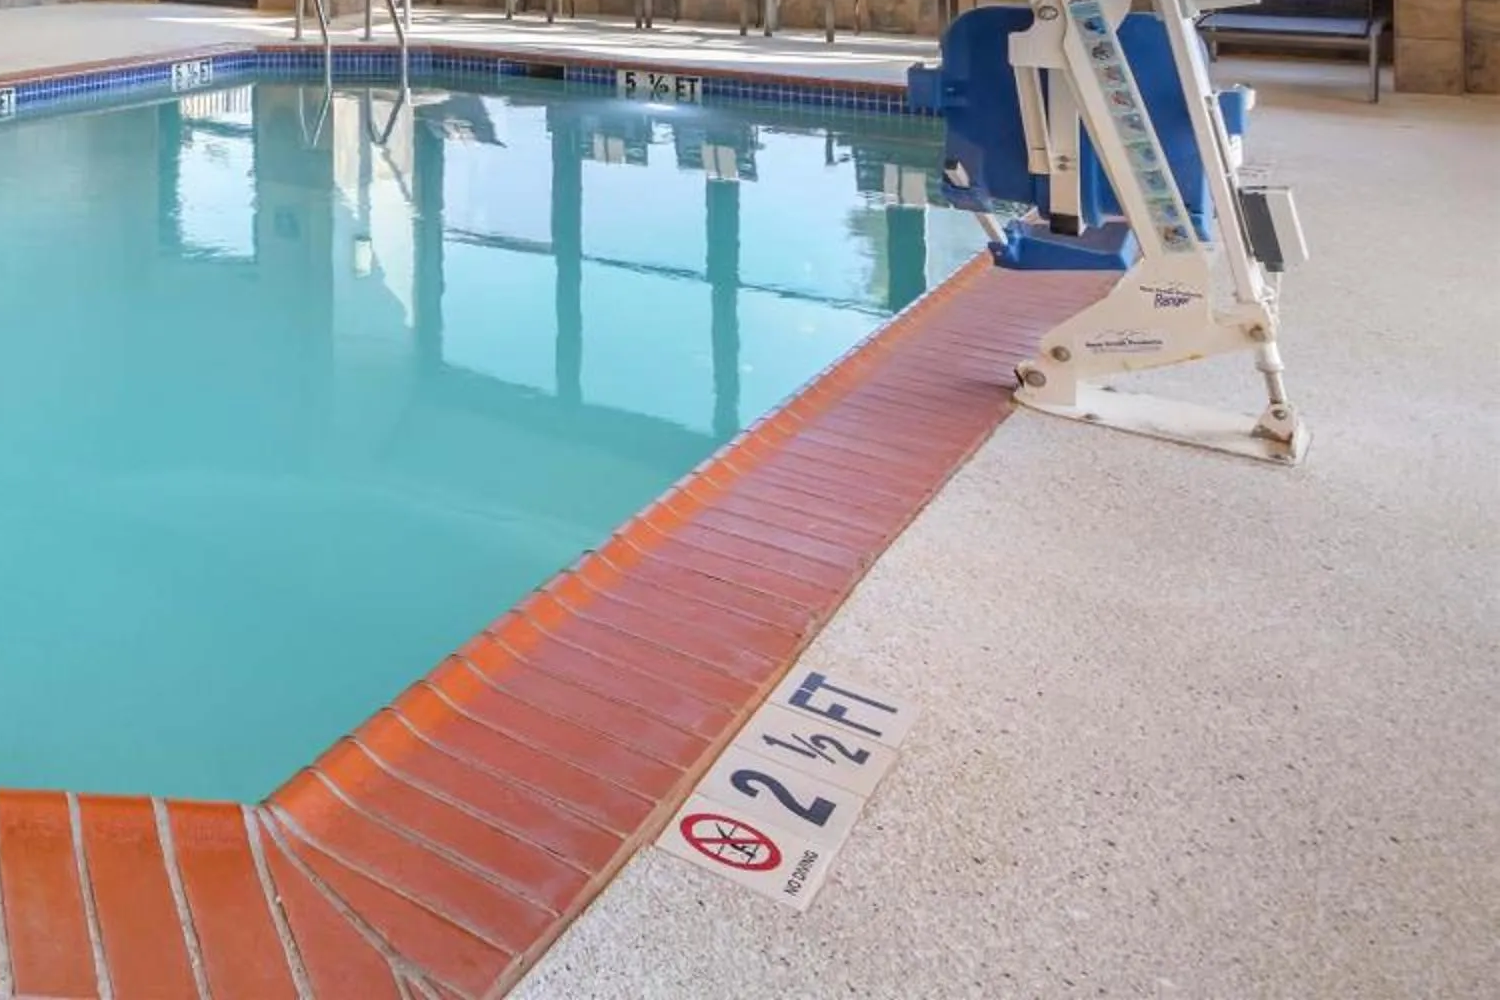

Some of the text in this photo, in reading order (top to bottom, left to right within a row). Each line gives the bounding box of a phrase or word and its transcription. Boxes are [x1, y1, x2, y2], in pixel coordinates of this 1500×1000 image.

[730, 769, 837, 828] 2
[788, 671, 898, 738] FT
[784, 849, 819, 897] NO DIVING
